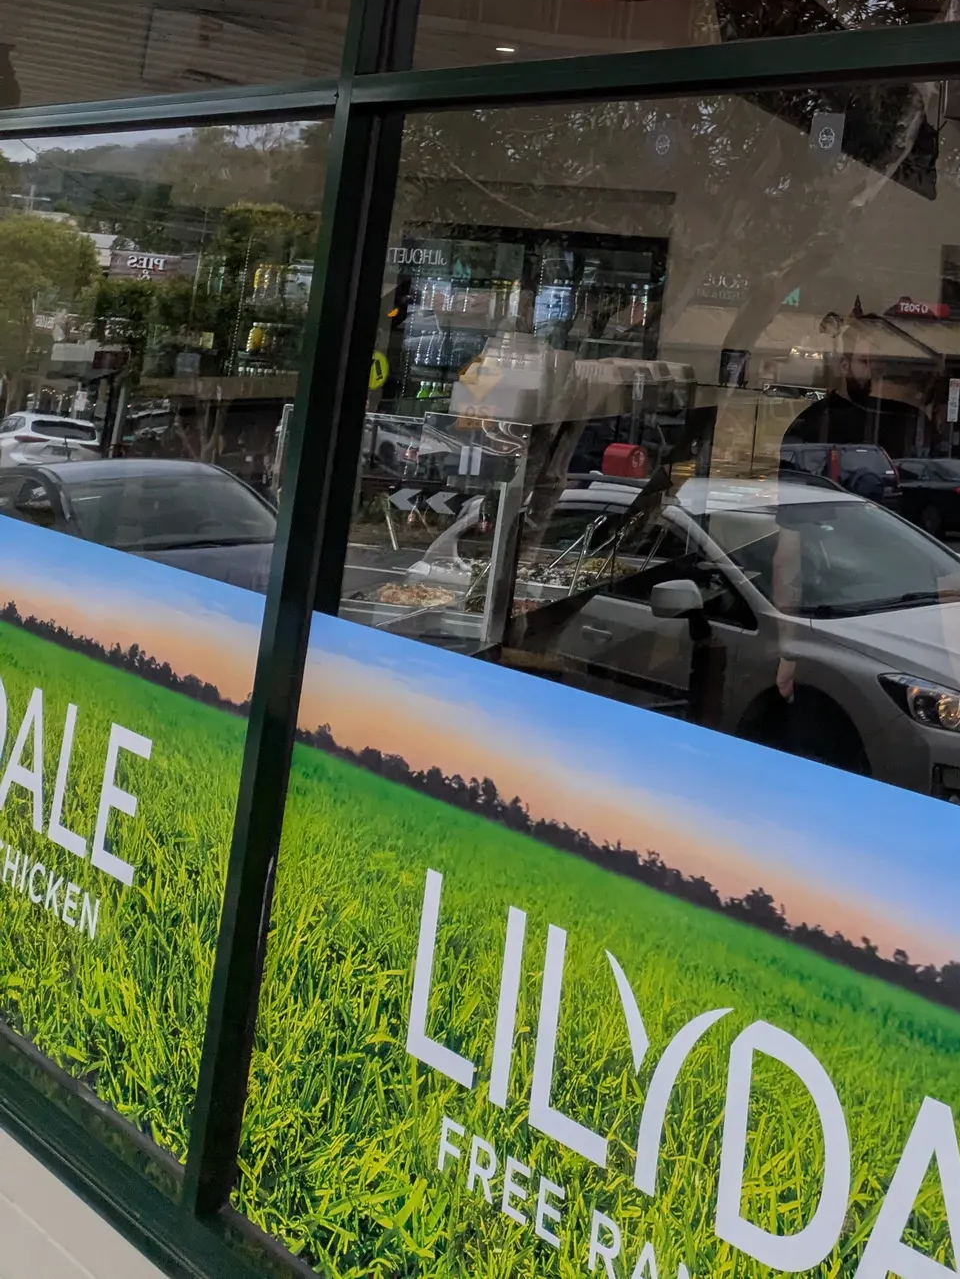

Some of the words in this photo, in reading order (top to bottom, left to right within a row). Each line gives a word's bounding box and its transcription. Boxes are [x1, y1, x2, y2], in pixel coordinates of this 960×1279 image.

[0, 677, 152, 887] ALE
[0, 839, 100, 940] HICKEN
[437, 1115, 566, 1249] FREE
